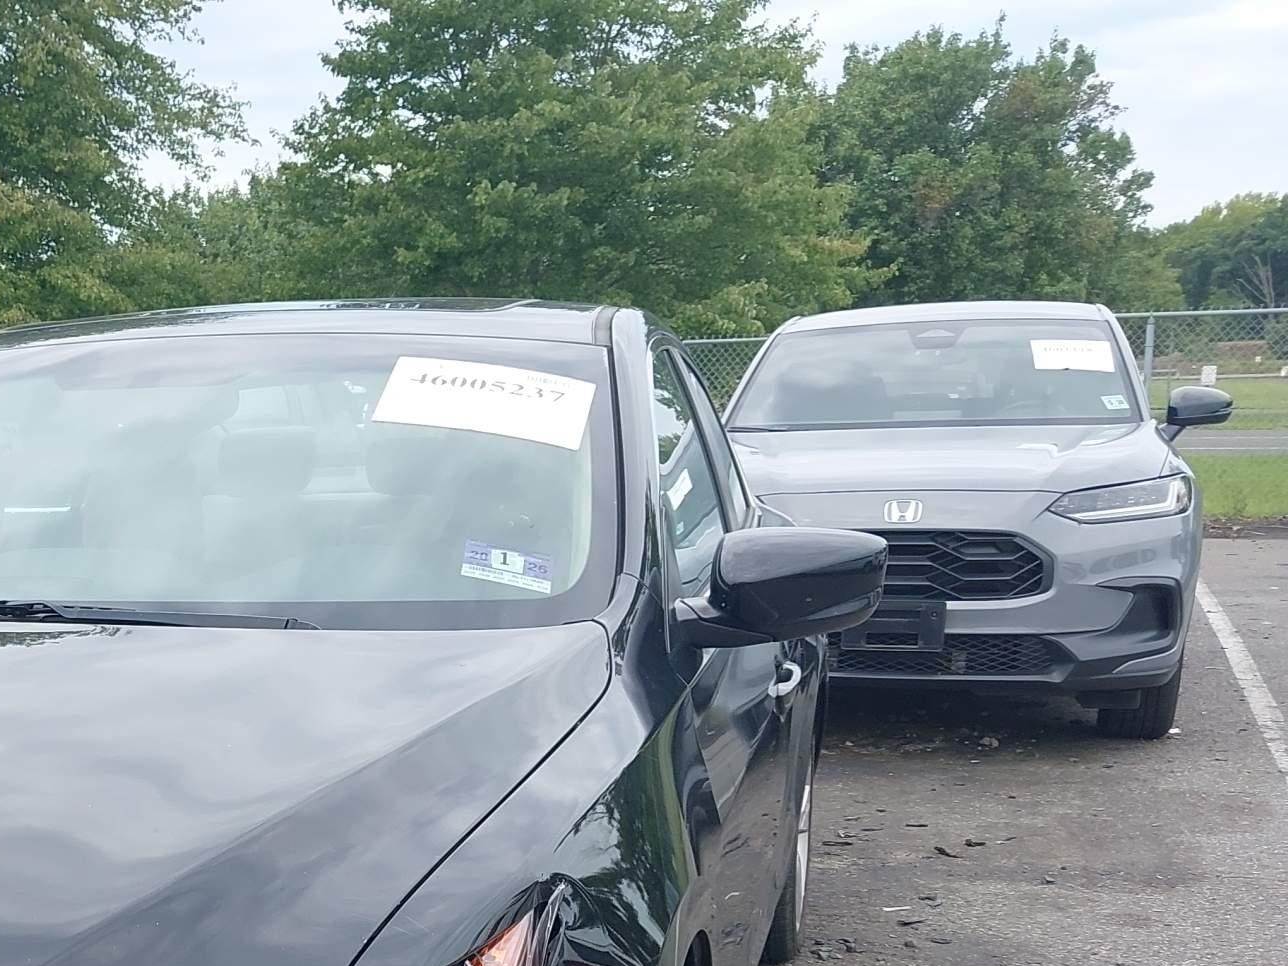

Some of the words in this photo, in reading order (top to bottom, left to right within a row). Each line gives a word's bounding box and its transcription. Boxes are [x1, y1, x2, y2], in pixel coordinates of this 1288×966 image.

[409, 372, 567, 403] 46005237
[499, 551, 510, 566] 1
[527, 562, 548, 575] 26
